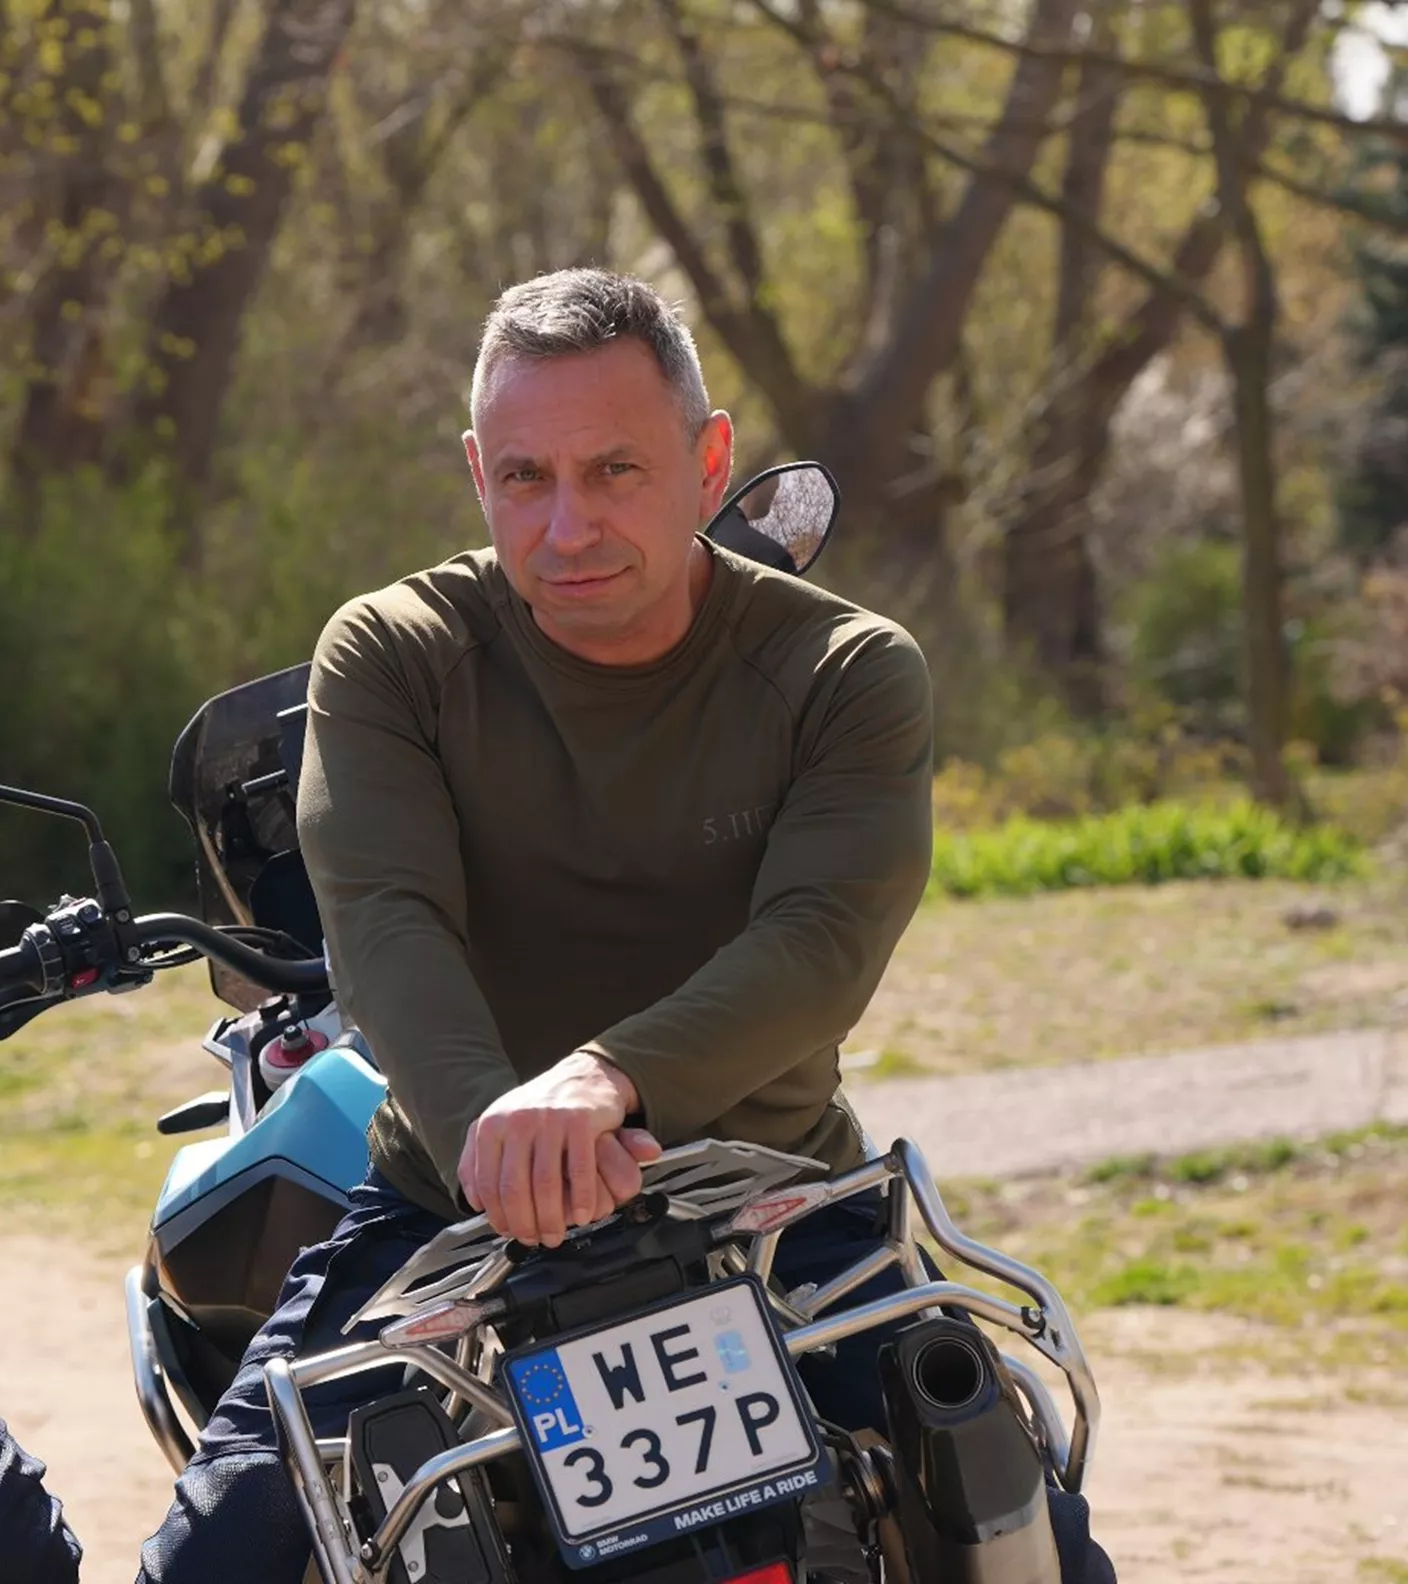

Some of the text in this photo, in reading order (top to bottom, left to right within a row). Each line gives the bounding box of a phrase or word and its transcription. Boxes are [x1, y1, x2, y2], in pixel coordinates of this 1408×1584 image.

[592, 1323, 708, 1411] WE
[532, 1407, 580, 1444] PL
[562, 1391, 781, 1509] 337P
[673, 1470, 818, 1531] MAKE LIFE A RIDE
